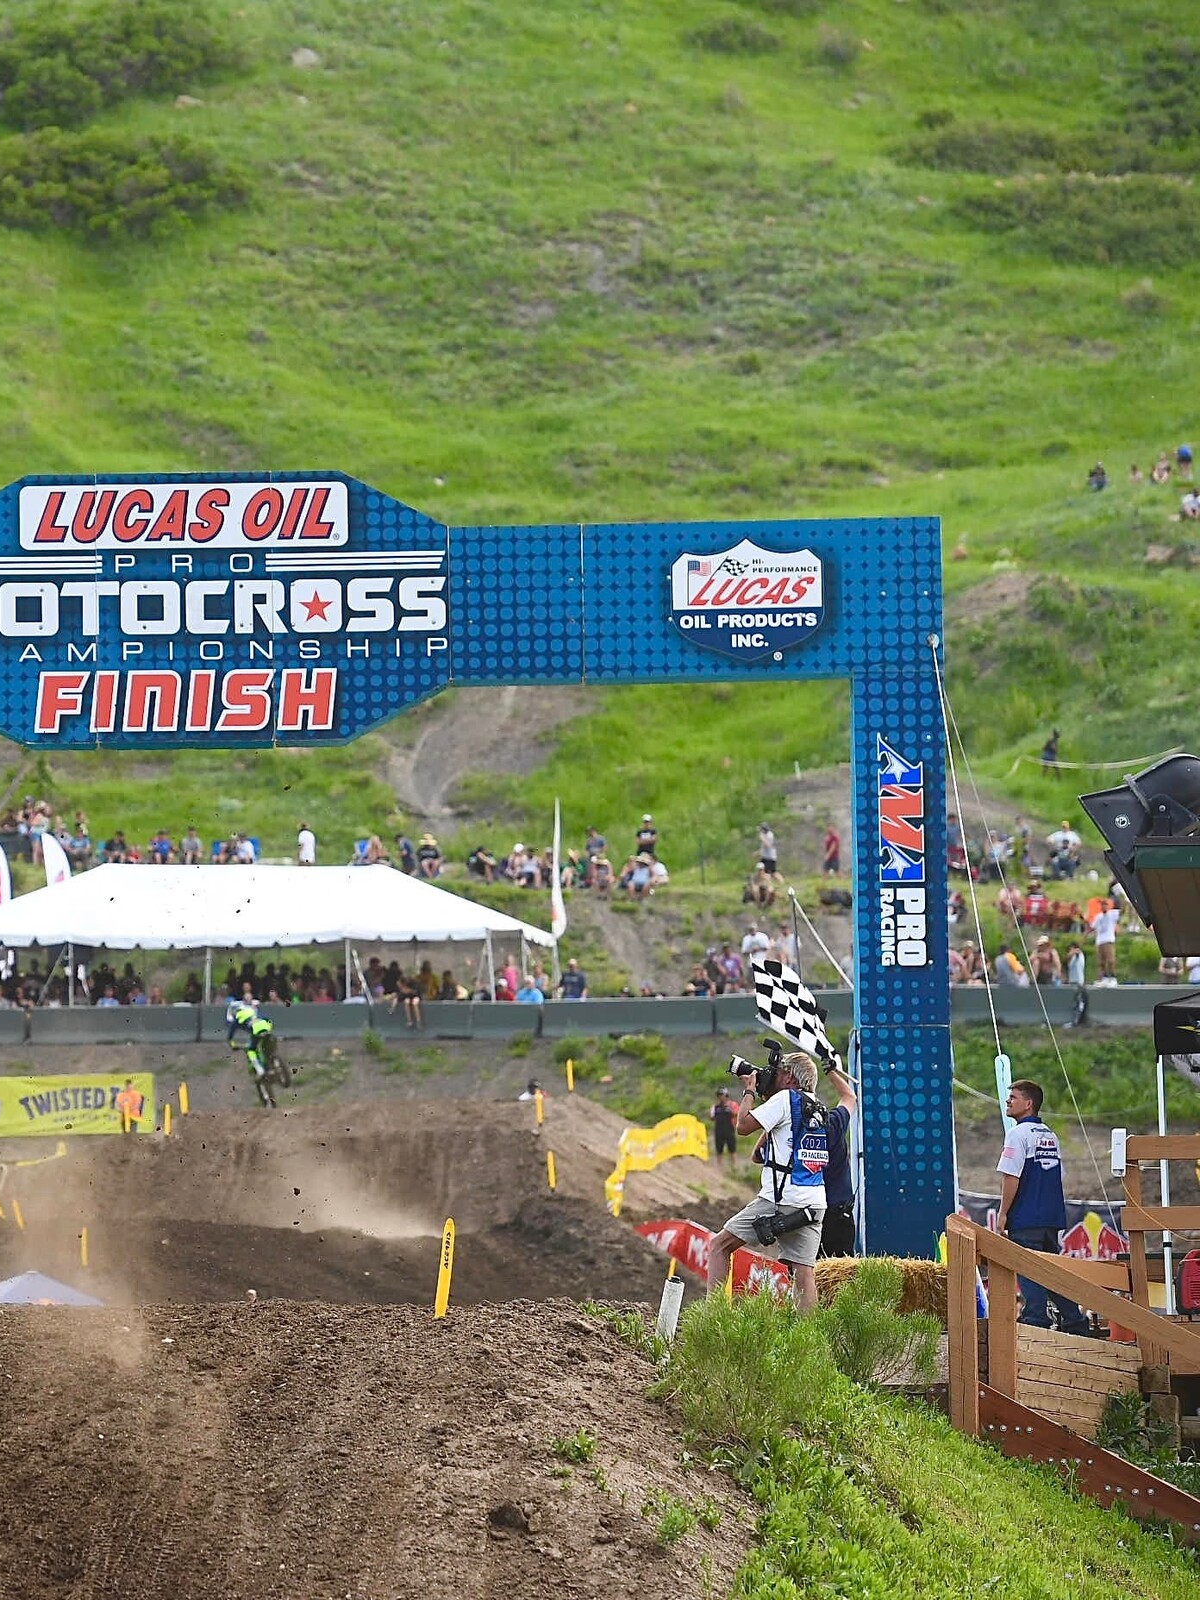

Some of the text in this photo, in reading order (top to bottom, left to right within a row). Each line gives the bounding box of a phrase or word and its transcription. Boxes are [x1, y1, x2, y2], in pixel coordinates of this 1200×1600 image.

[33, 487, 335, 543] LUCAS OIL
[114, 553, 254, 574] PRO
[689, 577, 816, 606] LUCAS
[679, 613, 818, 629] OIL PRODUCTS
[731, 633, 769, 648] INC.
[34, 667, 338, 734] FINISH
[877, 732, 926, 883] AMA
[879, 887, 896, 967] RACING
[896, 887, 927, 967] PRO
[19, 1087, 105, 1120] TWISTED
[805, 1137, 827, 1149] 2021
